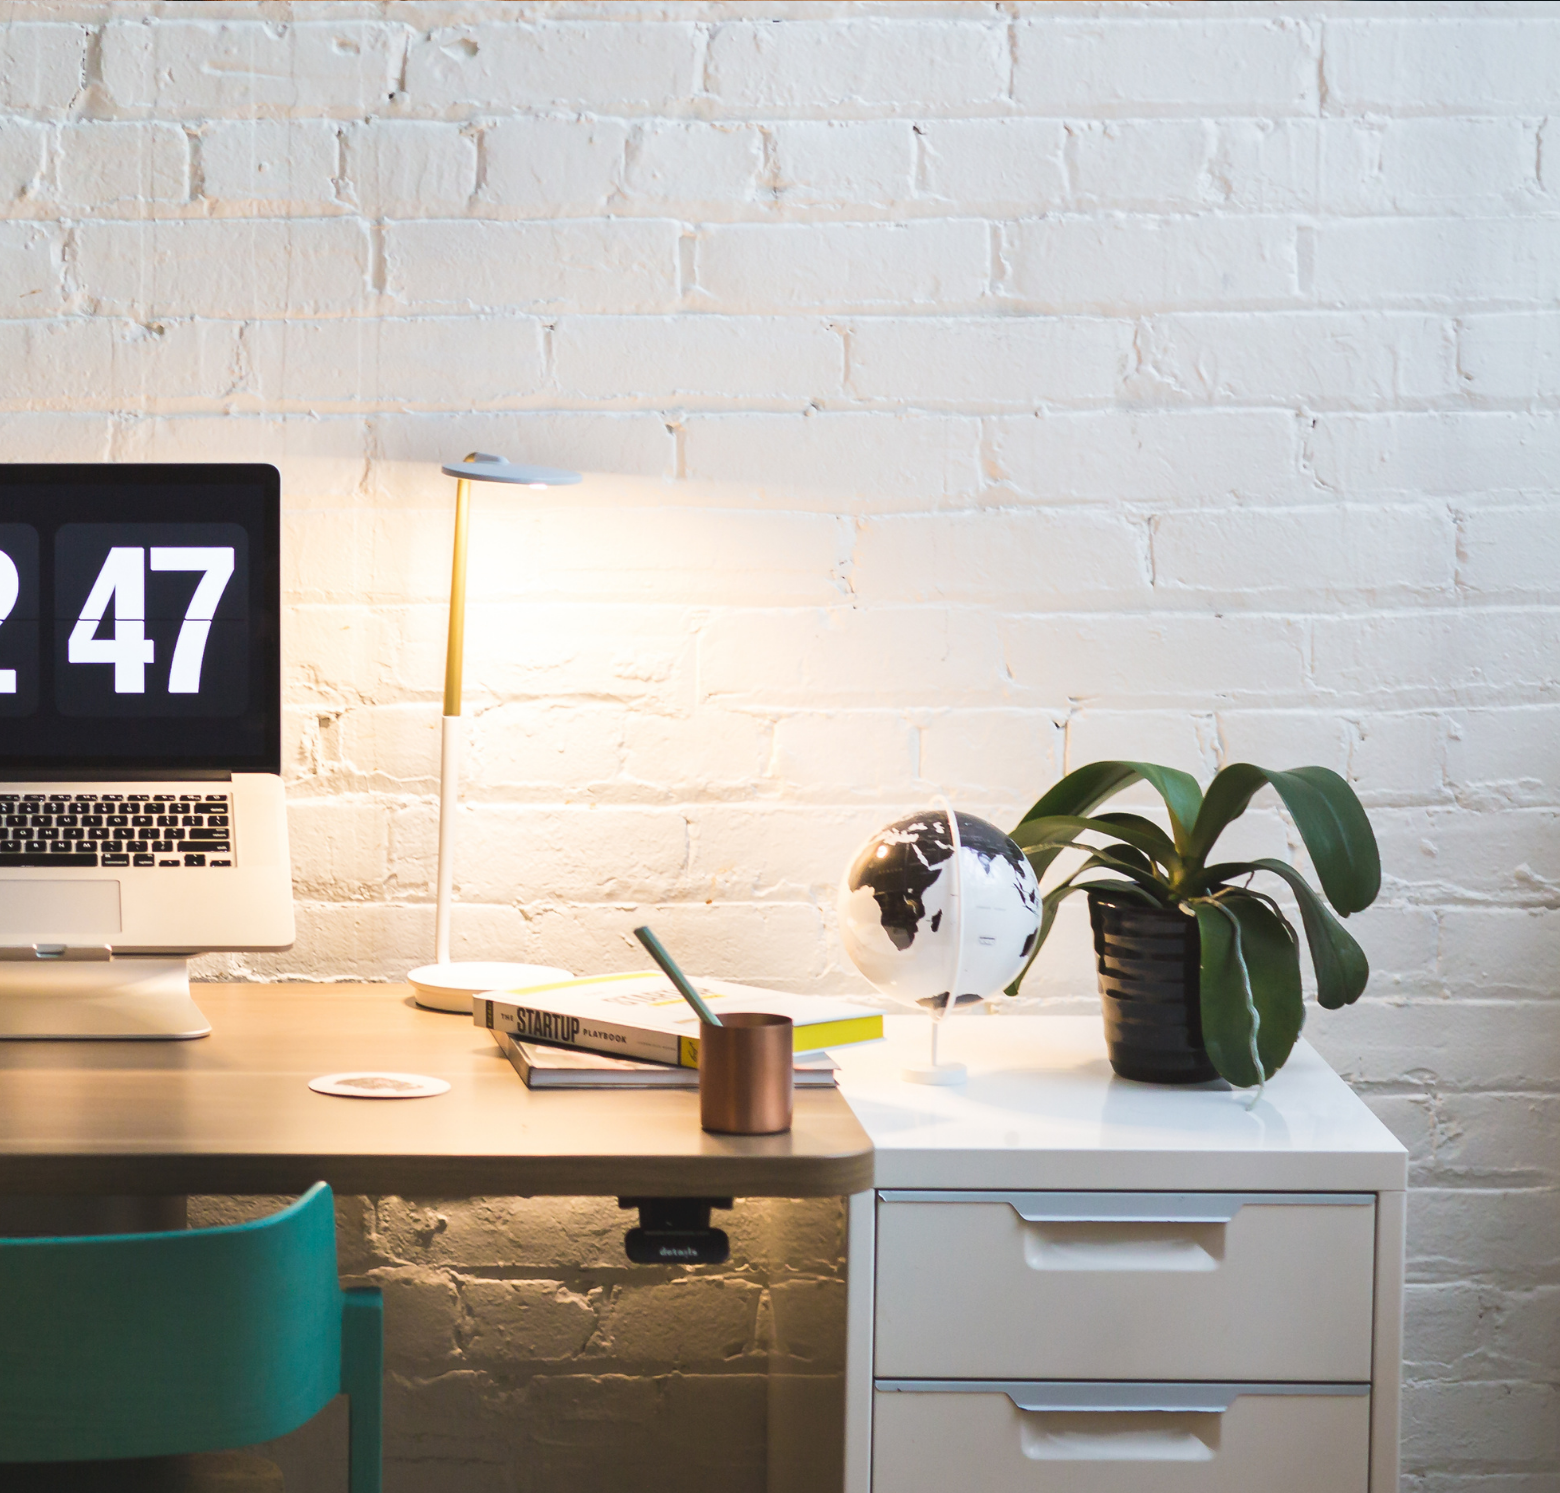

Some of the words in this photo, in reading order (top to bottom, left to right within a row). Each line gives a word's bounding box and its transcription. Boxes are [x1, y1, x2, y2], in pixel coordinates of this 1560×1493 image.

[68, 546, 235, 693] 47
[501, 1012, 514, 1022] THE
[516, 1007, 580, 1044] STARTUP
[582, 1029, 627, 1044] PLAYBOOK
